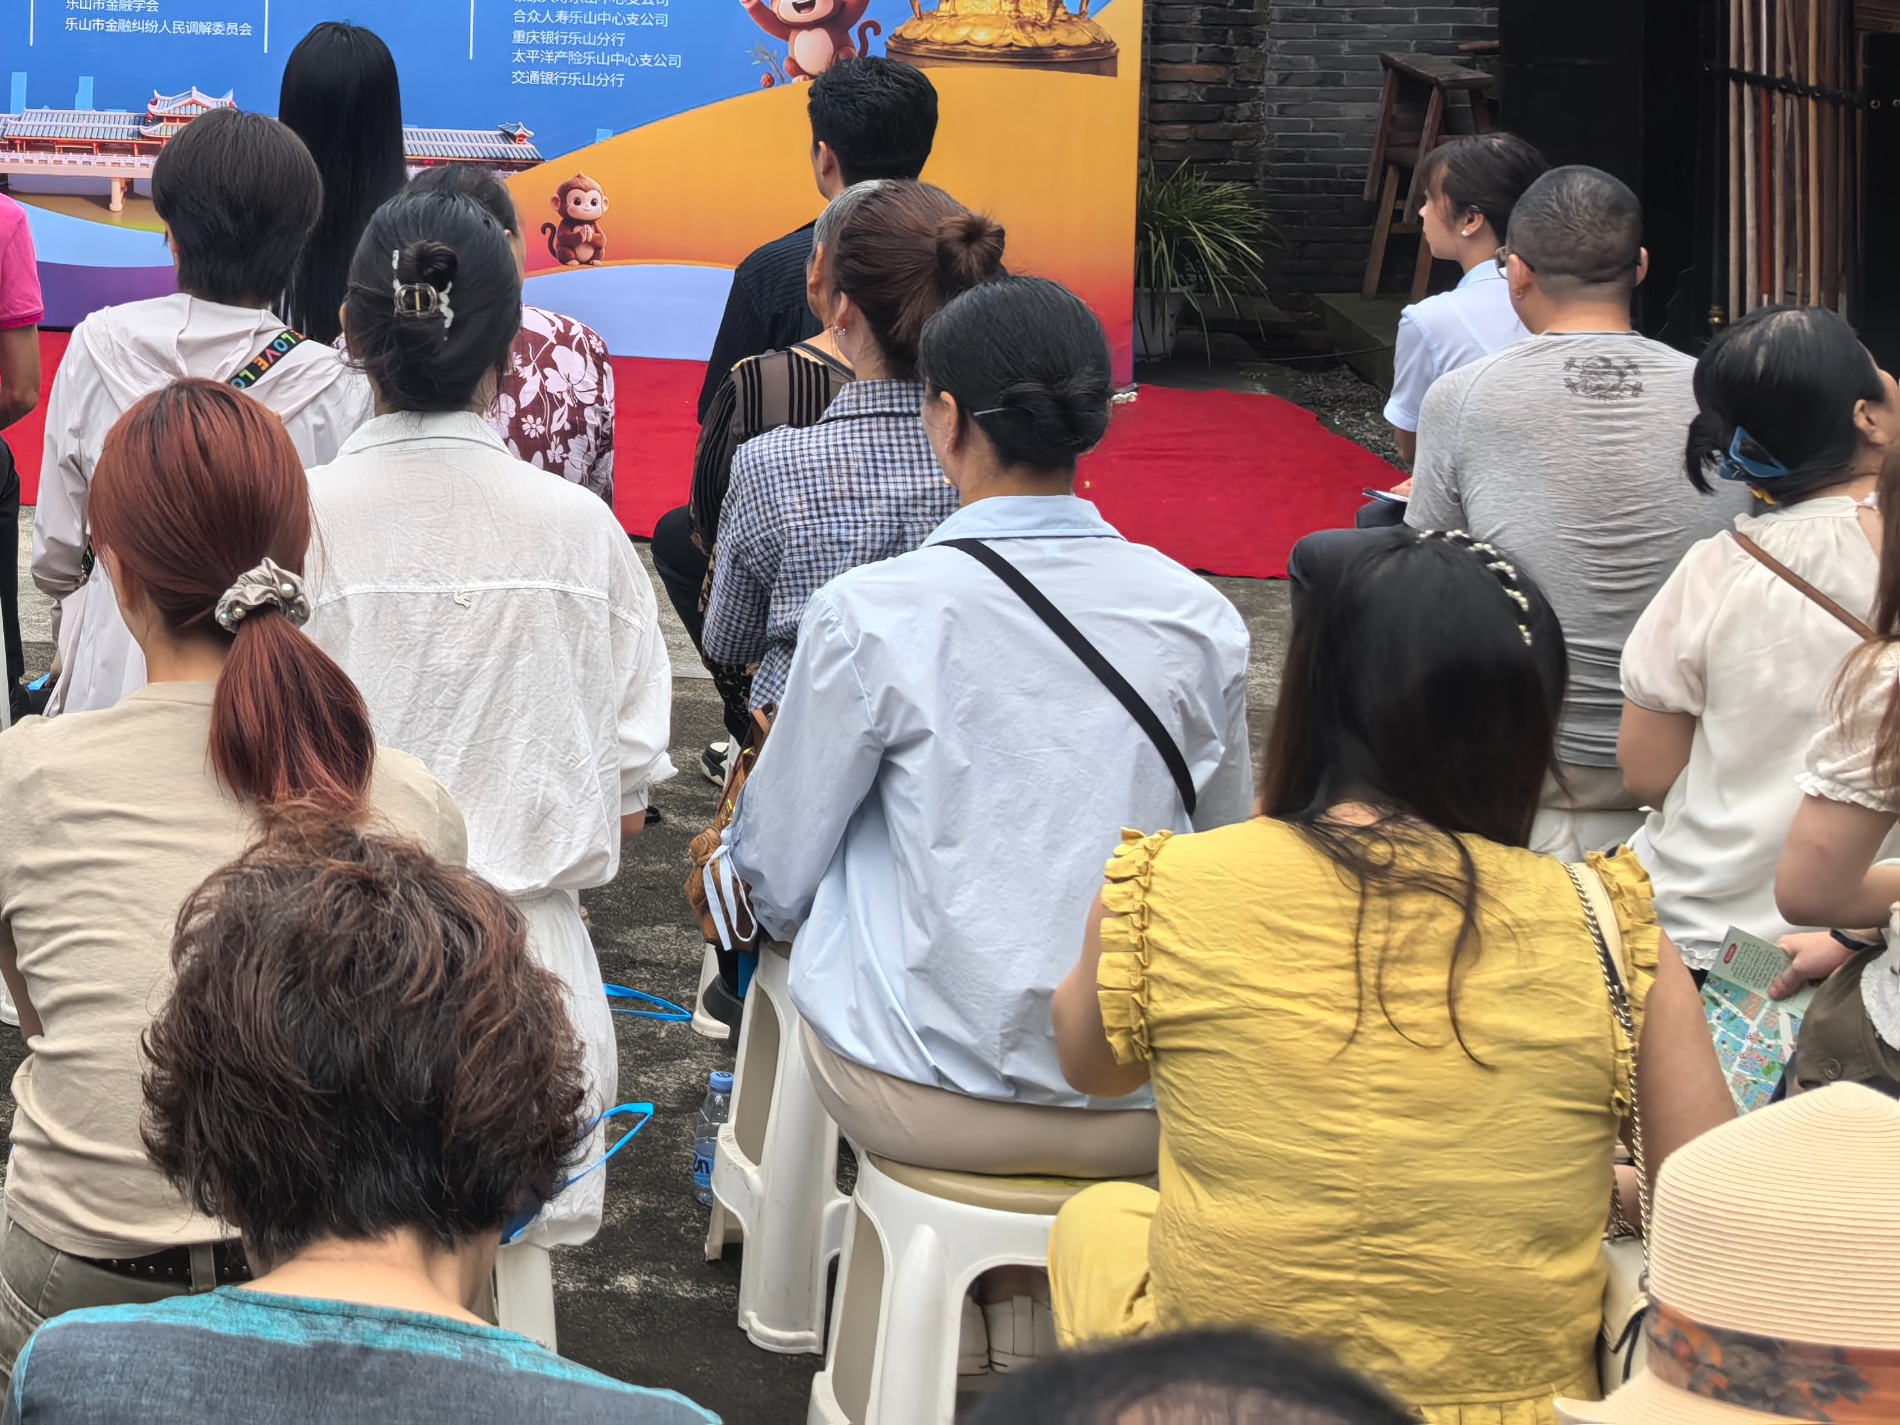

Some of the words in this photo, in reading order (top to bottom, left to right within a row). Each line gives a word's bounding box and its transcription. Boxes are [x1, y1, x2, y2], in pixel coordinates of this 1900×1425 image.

[64, 17, 253, 36] 乐山市金融纠纷人民调解委员会
[513, 9, 669, 27] 合众人寿乐山中心支公司
[512, 29, 626, 47] 重庆银行乐山分行
[511, 49, 682, 69] 太平洋产险乐山中心支公司
[511, 70, 625, 88] 交通银行乐山分行
[253, 332, 297, 371] LOVE
